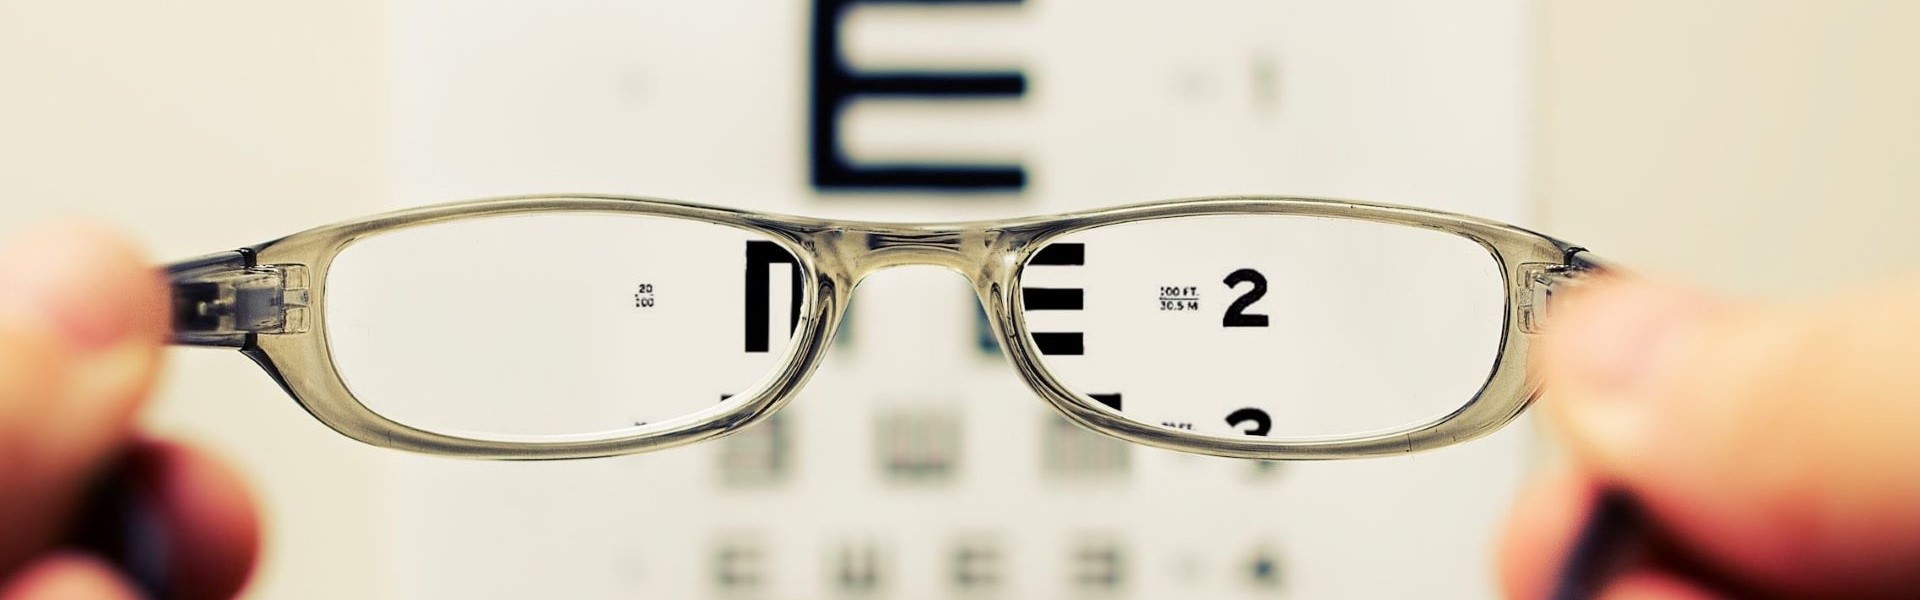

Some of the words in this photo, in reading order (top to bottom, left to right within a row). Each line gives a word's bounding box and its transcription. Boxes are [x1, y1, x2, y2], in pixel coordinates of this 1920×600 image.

[808, 0, 1027, 191] E
[638, 283, 654, 294] 20
[1187, 300, 1199, 311] M
[1222, 268, 1270, 328] 2
